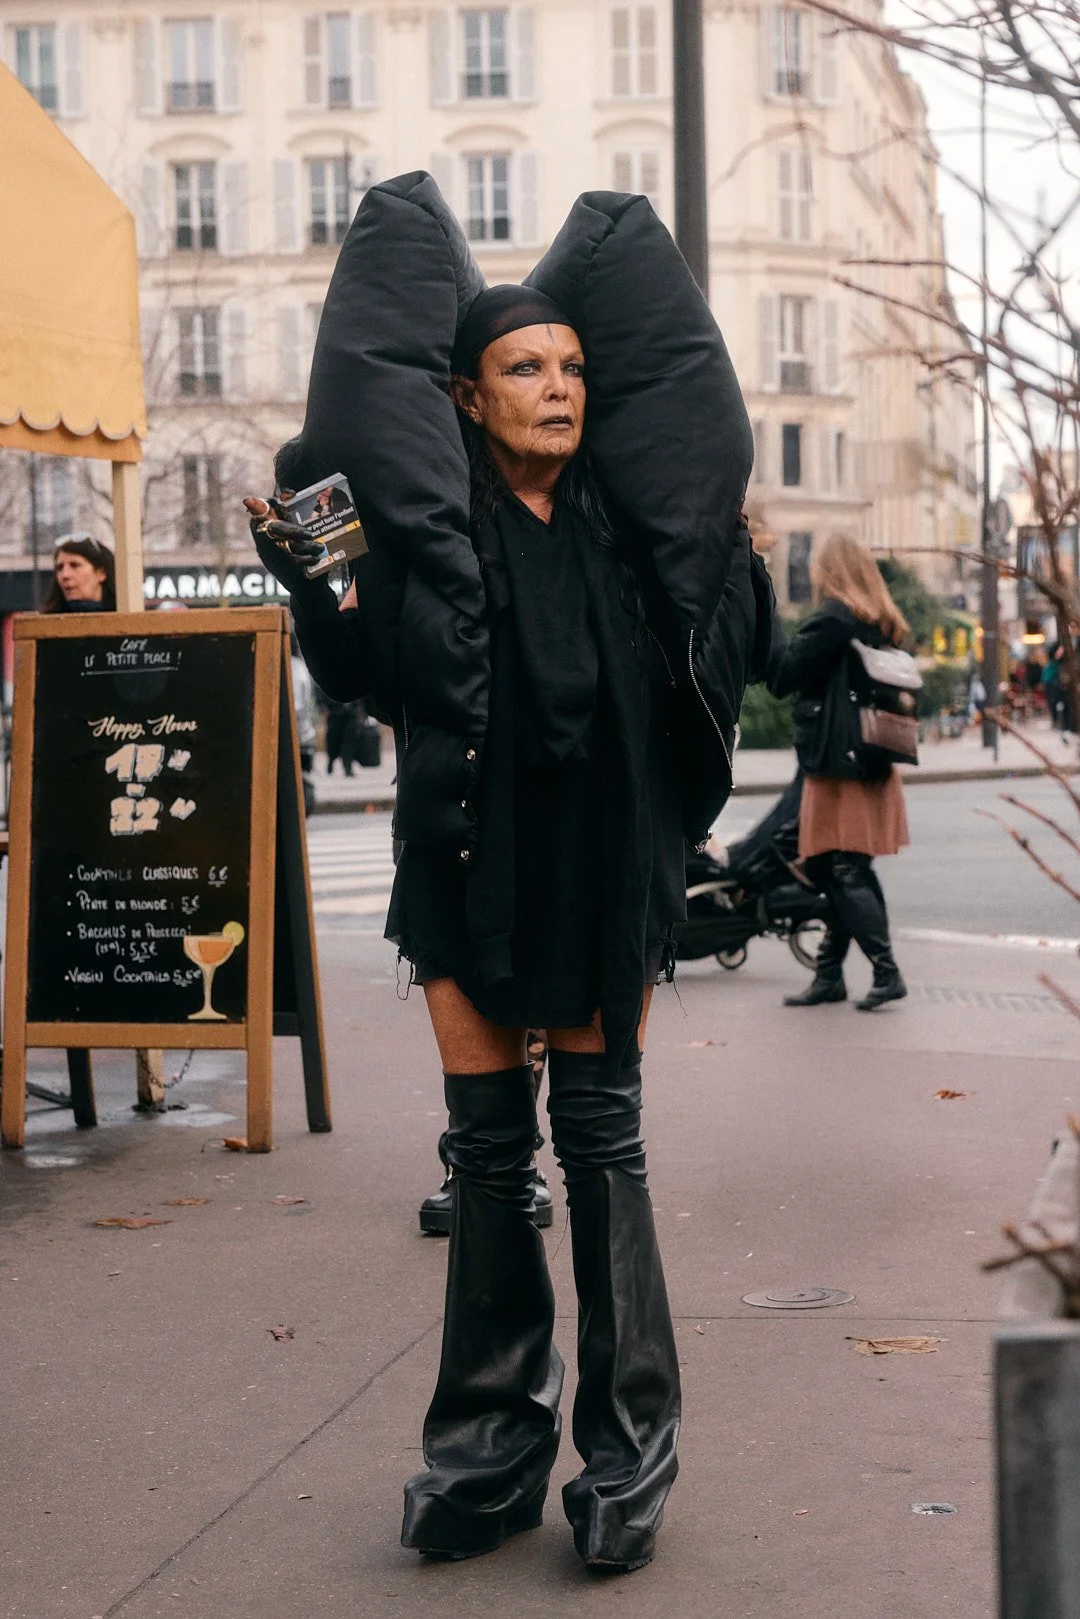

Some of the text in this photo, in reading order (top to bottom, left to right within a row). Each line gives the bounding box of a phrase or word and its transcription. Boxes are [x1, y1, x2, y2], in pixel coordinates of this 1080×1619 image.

[335, 506, 354, 519] l'enfant
[320, 520, 342, 533] attendez
[142, 573, 291, 599] HARMACI
[147, 714, 198, 736] Hours
